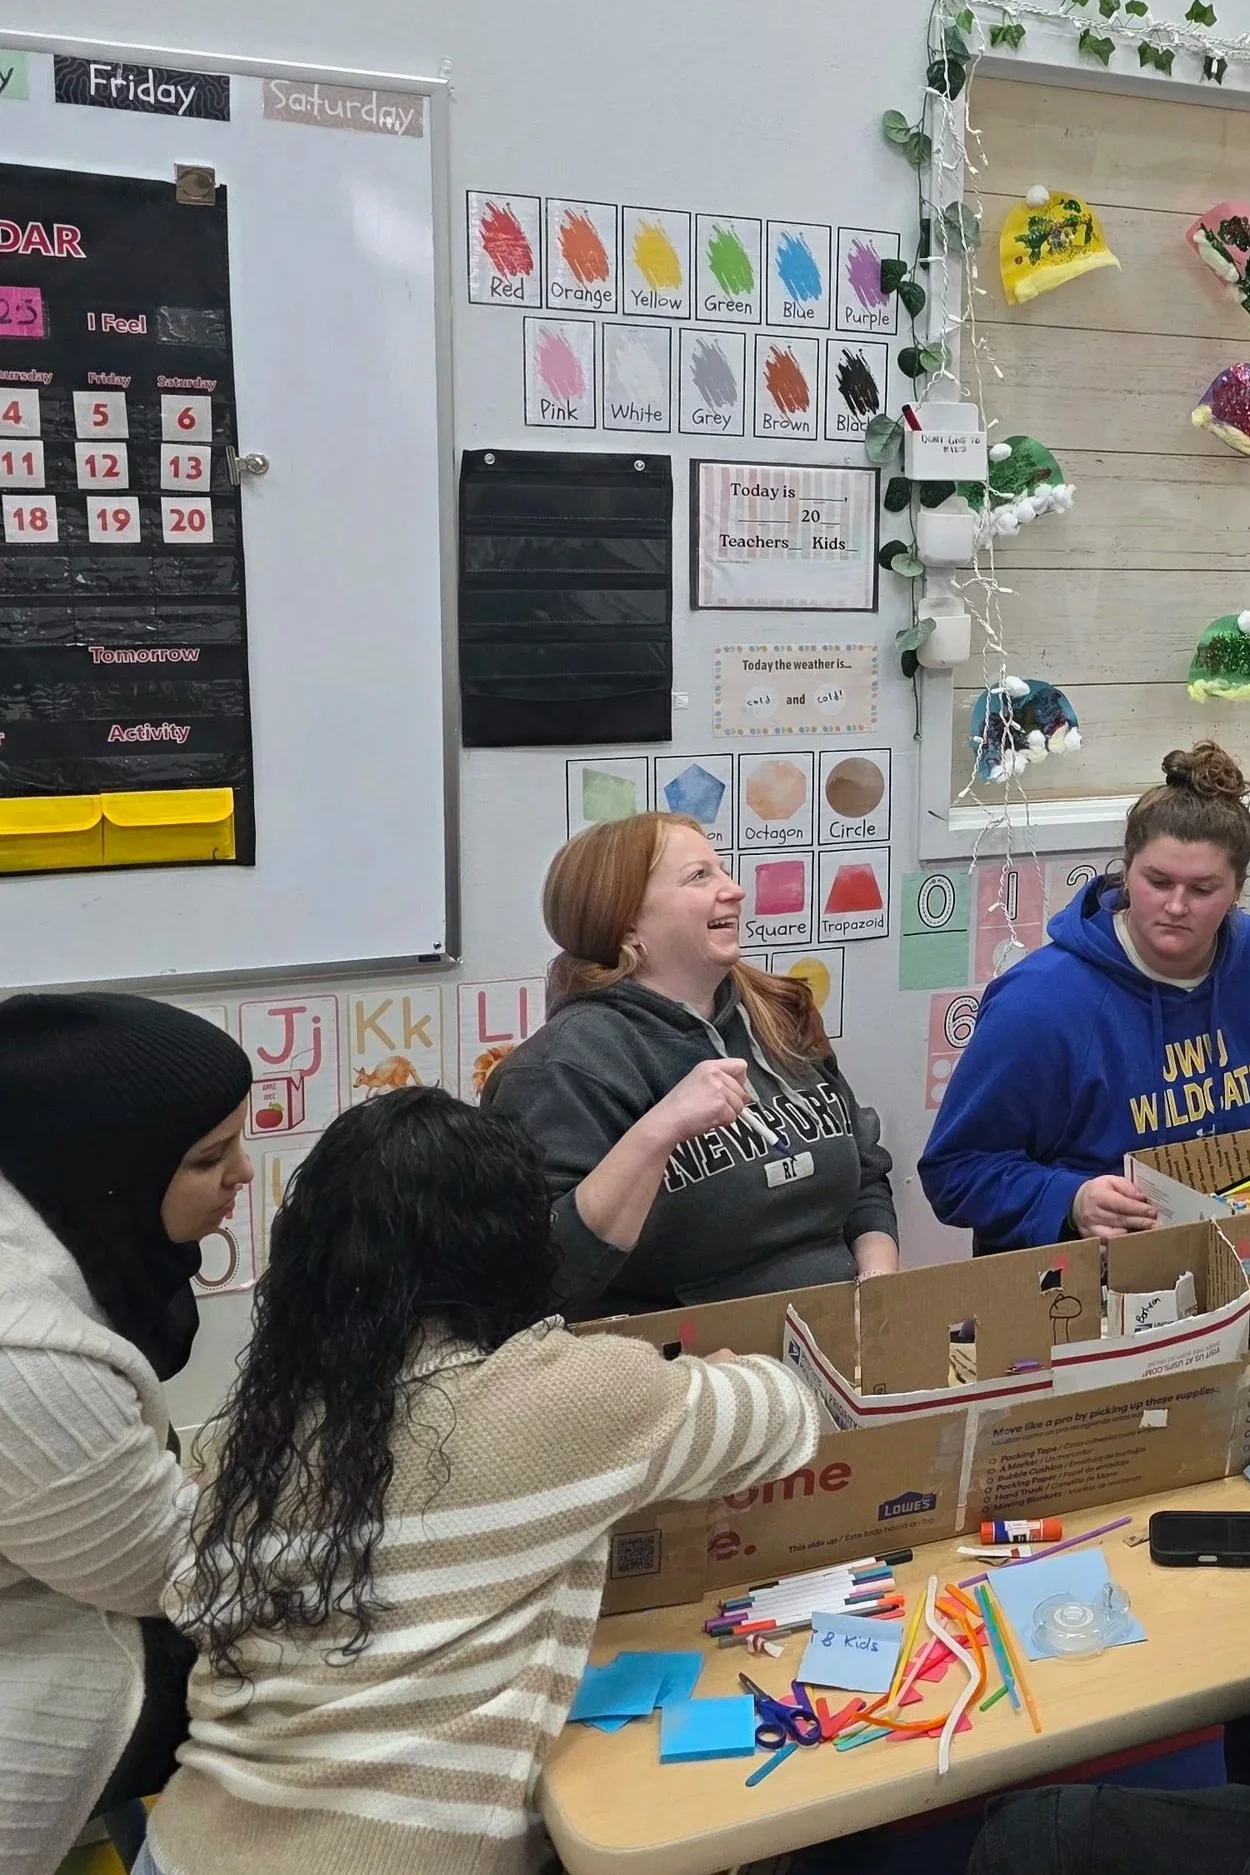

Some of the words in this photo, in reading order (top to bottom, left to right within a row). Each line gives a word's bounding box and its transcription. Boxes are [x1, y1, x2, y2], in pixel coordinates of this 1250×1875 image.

[89, 64, 196, 116] Friday
[269, 79, 415, 136] Saturday
[490, 276, 525, 299] Red
[551, 282, 613, 309] Orange
[630, 289, 683, 310] Yellow
[704, 295, 753, 315] Green
[783, 301, 815, 320] Blue
[845, 306, 890, 331] Purple
[87, 312, 96, 331] I
[101, 313, 148, 334] Feel
[87, 371, 131, 388] Friday
[156, 375, 217, 391] Saturday
[2, 401, 23, 425] 4
[92, 403, 109, 428] 5
[177, 407, 197, 430] 6
[540, 398, 579, 421] Pink
[611, 402, 663, 422] White
[691, 411, 732, 432] Grey
[762, 414, 810, 433] Brown
[1, 451, 34, 476] 11
[84, 454, 121, 478] 12
[168, 456, 203, 480] 13
[730, 482, 779, 500] Today
[783, 485, 796, 498] is
[12, 507, 49, 532] 18
[96, 508, 132, 532] 19
[169, 508, 206, 532] 20
[719, 534, 789, 548] Teachers
[812, 536, 846, 550] Kids
[88, 646, 200, 664] Tomorrow
[742, 659, 774, 673] Today
[774, 660, 791, 670] the
[794, 658, 834, 670] weather
[786, 694, 806, 705] and
[107, 722, 191, 744] Activity
[745, 826, 804, 845] Octagon
[829, 819, 876, 839] Circle
[745, 920, 807, 940] Square
[822, 914, 884, 935] Trapazoid
[355, 996, 433, 1055] Kk
[944, 995, 980, 1049] 6
[256, 1006, 323, 1077] Jj
[664, 1083, 854, 1193] NEWPORT
[1184, 1356, 1194, 1366] AT
[1194, 1353, 1205, 1362] US
[992, 1426, 1022, 1438] Move
[1024, 1421, 1043, 1432] like
[1054, 1417, 1073, 1428] pro
[1075, 1412, 1089, 1422] by
[1089, 1404, 1129, 1419] picking
[1130, 1401, 1144, 1412] up
[1145, 1396, 1174, 1407] these
[1000, 1450, 1035, 1462] Packing
[1037, 1446, 1057, 1455] Tape
[1007, 1460, 1037, 1471] Marker
[1029, 1464, 1063, 1476] Cushion
[788, 1543, 806, 1553] This
[807, 1540, 825, 1549] side
[826, 1537, 838, 1546] up
[822, 1631, 835, 1648] 8
[844, 1635, 879, 1653] Kids
